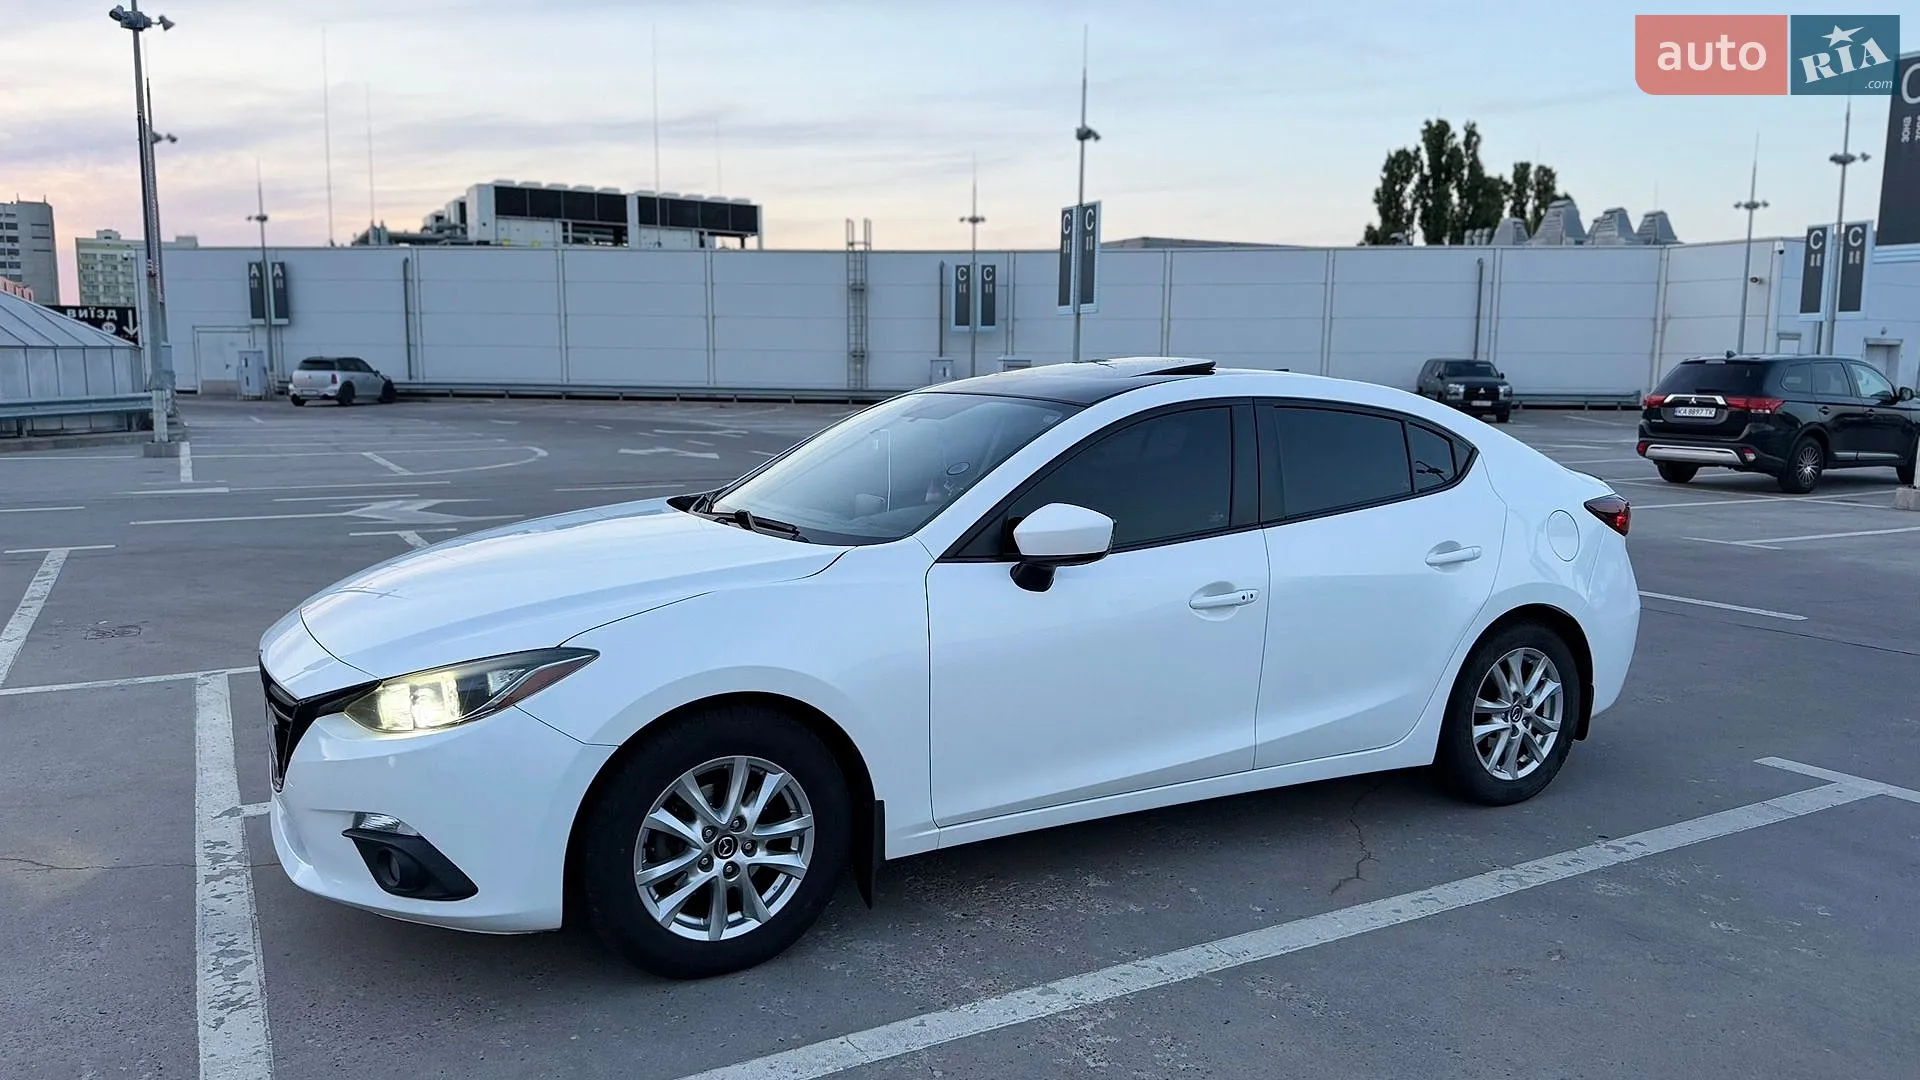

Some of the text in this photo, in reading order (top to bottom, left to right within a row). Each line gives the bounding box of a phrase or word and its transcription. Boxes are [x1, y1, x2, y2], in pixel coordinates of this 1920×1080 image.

[1063, 213, 1071, 234] C
[1086, 208, 1094, 231] C
[1810, 230, 1823, 250] C
[1848, 226, 1862, 247] C
[250, 263, 260, 277] A
[273, 263, 284, 277] A
[957, 266, 967, 281] C
[983, 266, 993, 281] C
